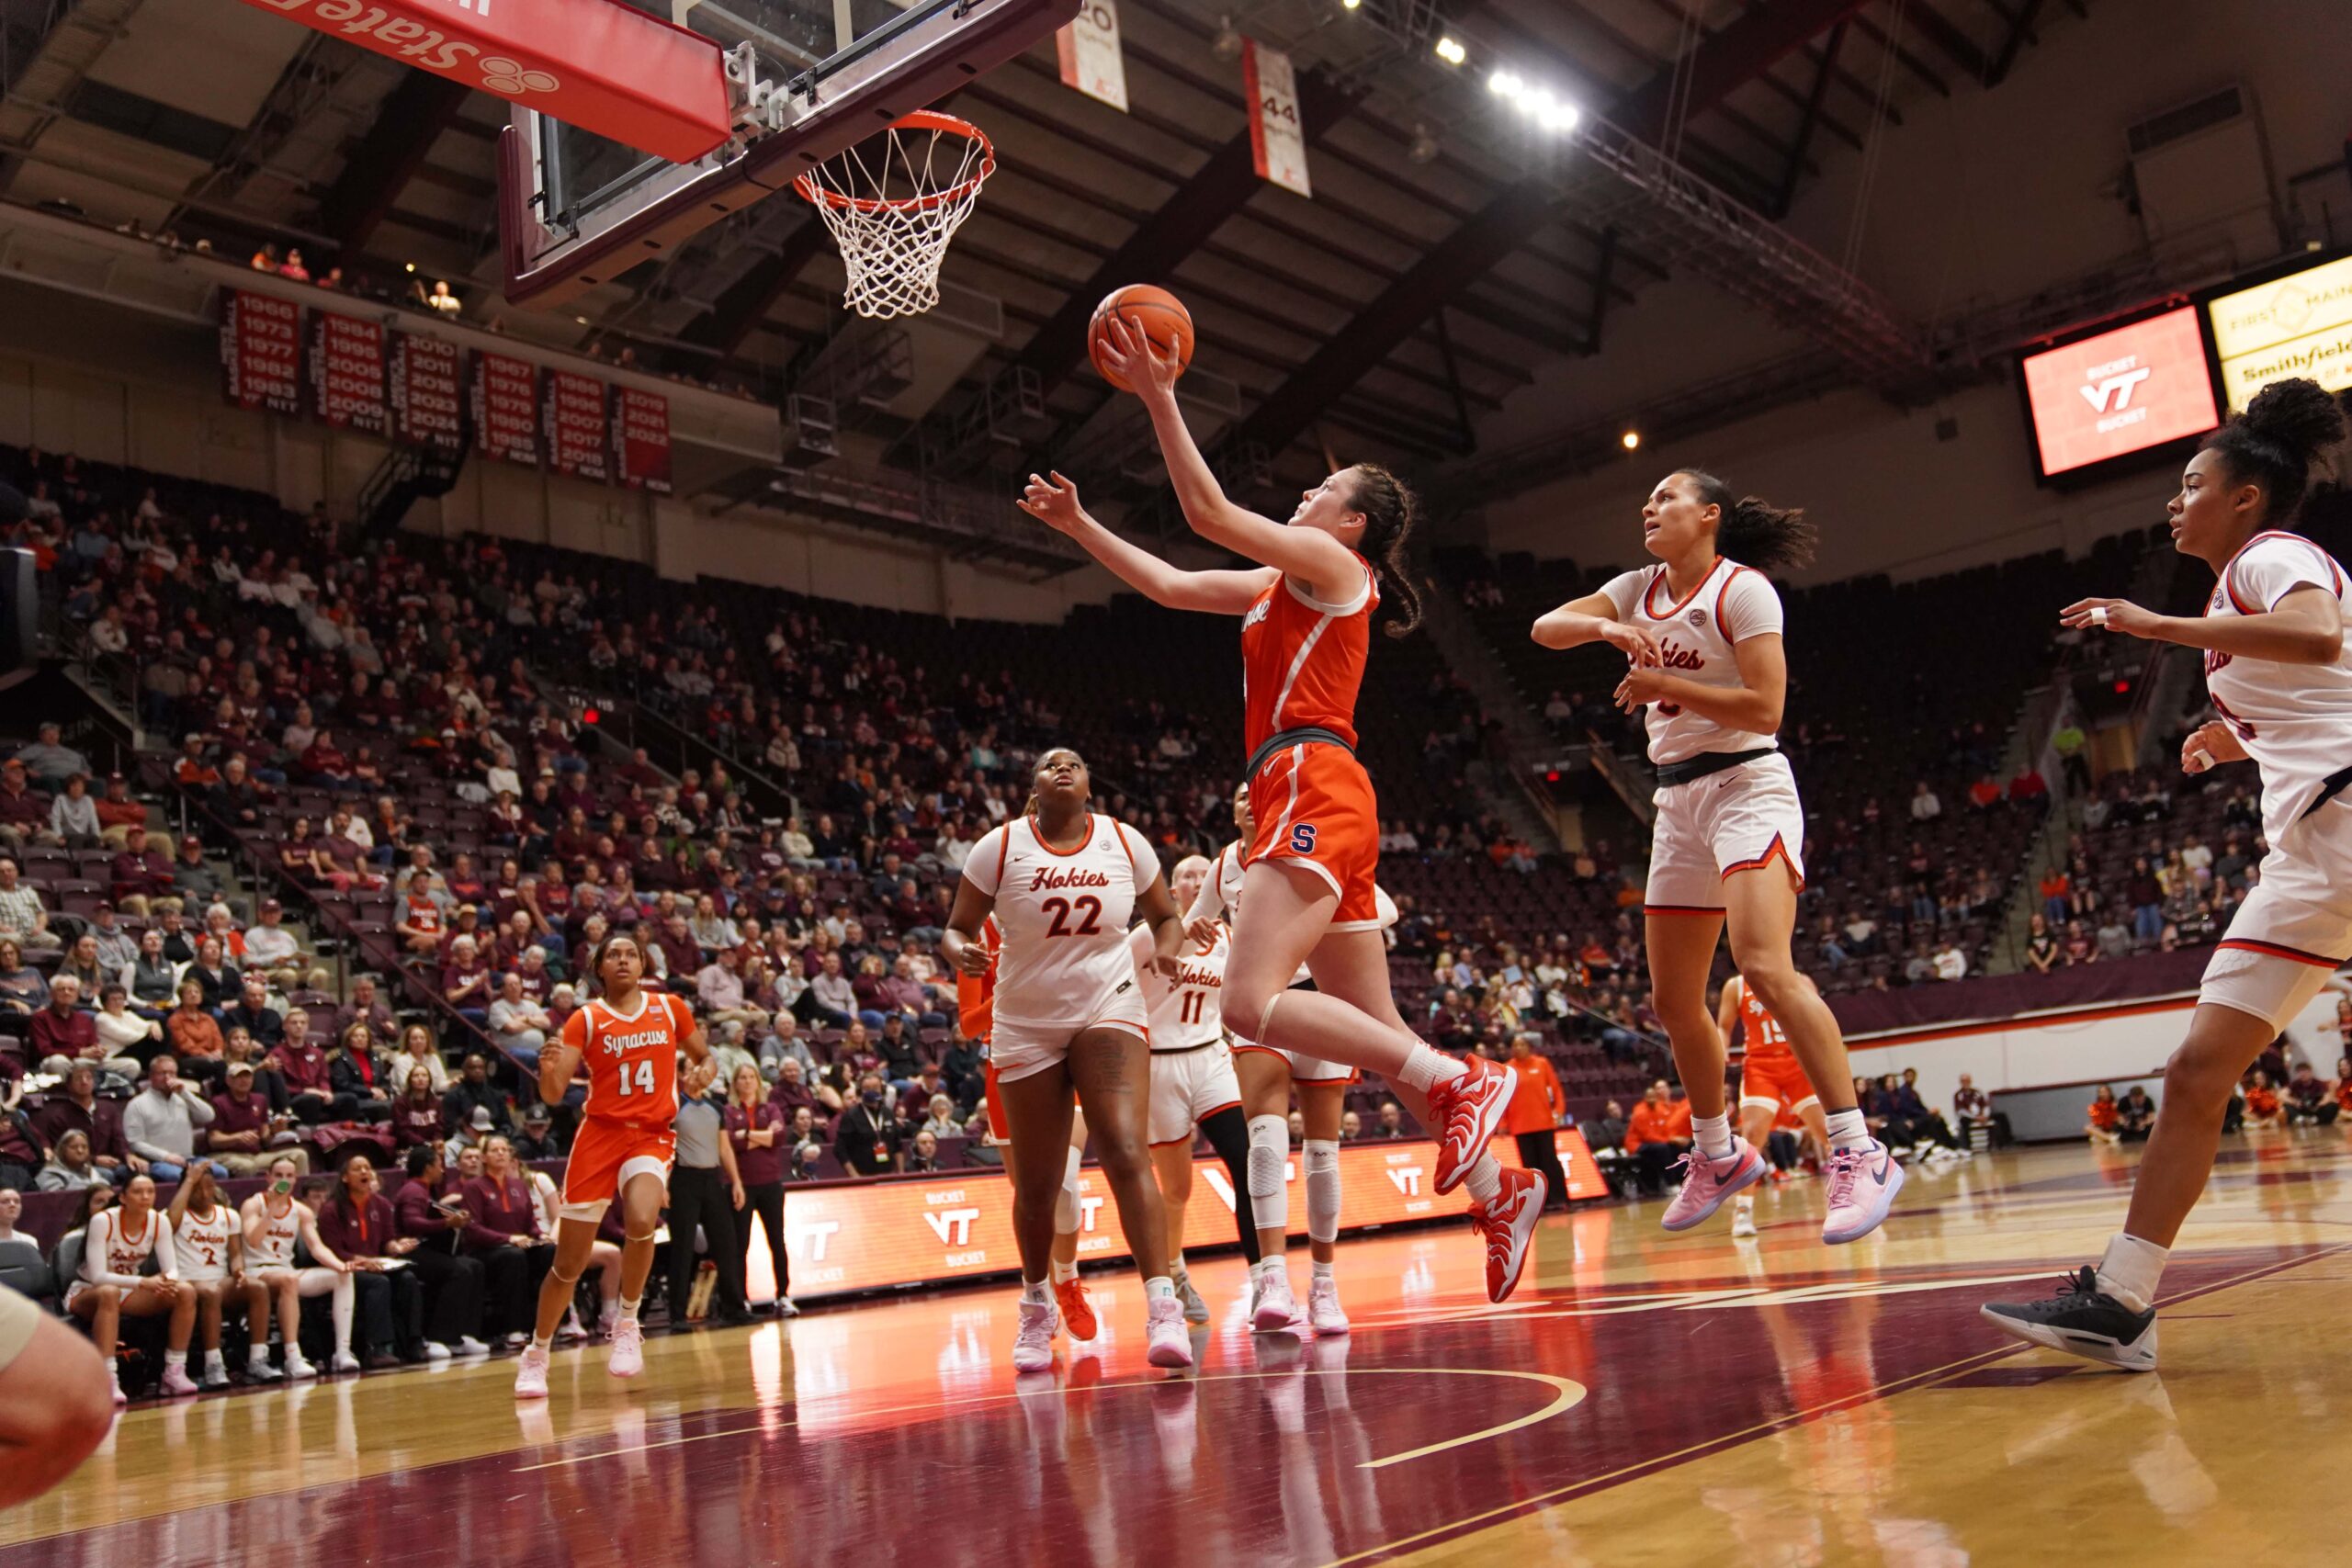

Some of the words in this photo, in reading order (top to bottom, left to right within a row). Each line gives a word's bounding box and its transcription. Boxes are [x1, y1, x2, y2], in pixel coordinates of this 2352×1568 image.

[315, 0, 480, 69] State
[1263, 97, 1295, 124] 44
[244, 317, 293, 339] 1973
[244, 336, 293, 359] 1977
[408, 335, 455, 357] 2010
[412, 355, 453, 376] 2011
[2079, 367, 2151, 412] VT
[412, 410, 458, 431] 2024
[560, 410, 603, 431] 2007
[628, 409, 665, 429] 2021
[562, 428, 603, 448] 2017
[627, 426, 668, 447] 2022
[1291, 823, 1317, 854] S
[1029, 866, 1109, 892] Hokies
[1042, 895, 1102, 939] 22
[1181, 990, 1205, 1024] 11
[604, 1030, 669, 1058] Syracuse
[619, 1060, 655, 1096] 14
[1386, 1168, 1423, 1196] VT
[925, 1190, 965, 1205] BUCKET
[922, 1208, 979, 1246] VT
[201, 1247, 218, 1266] 2
[944, 1250, 987, 1268] BUCKET
